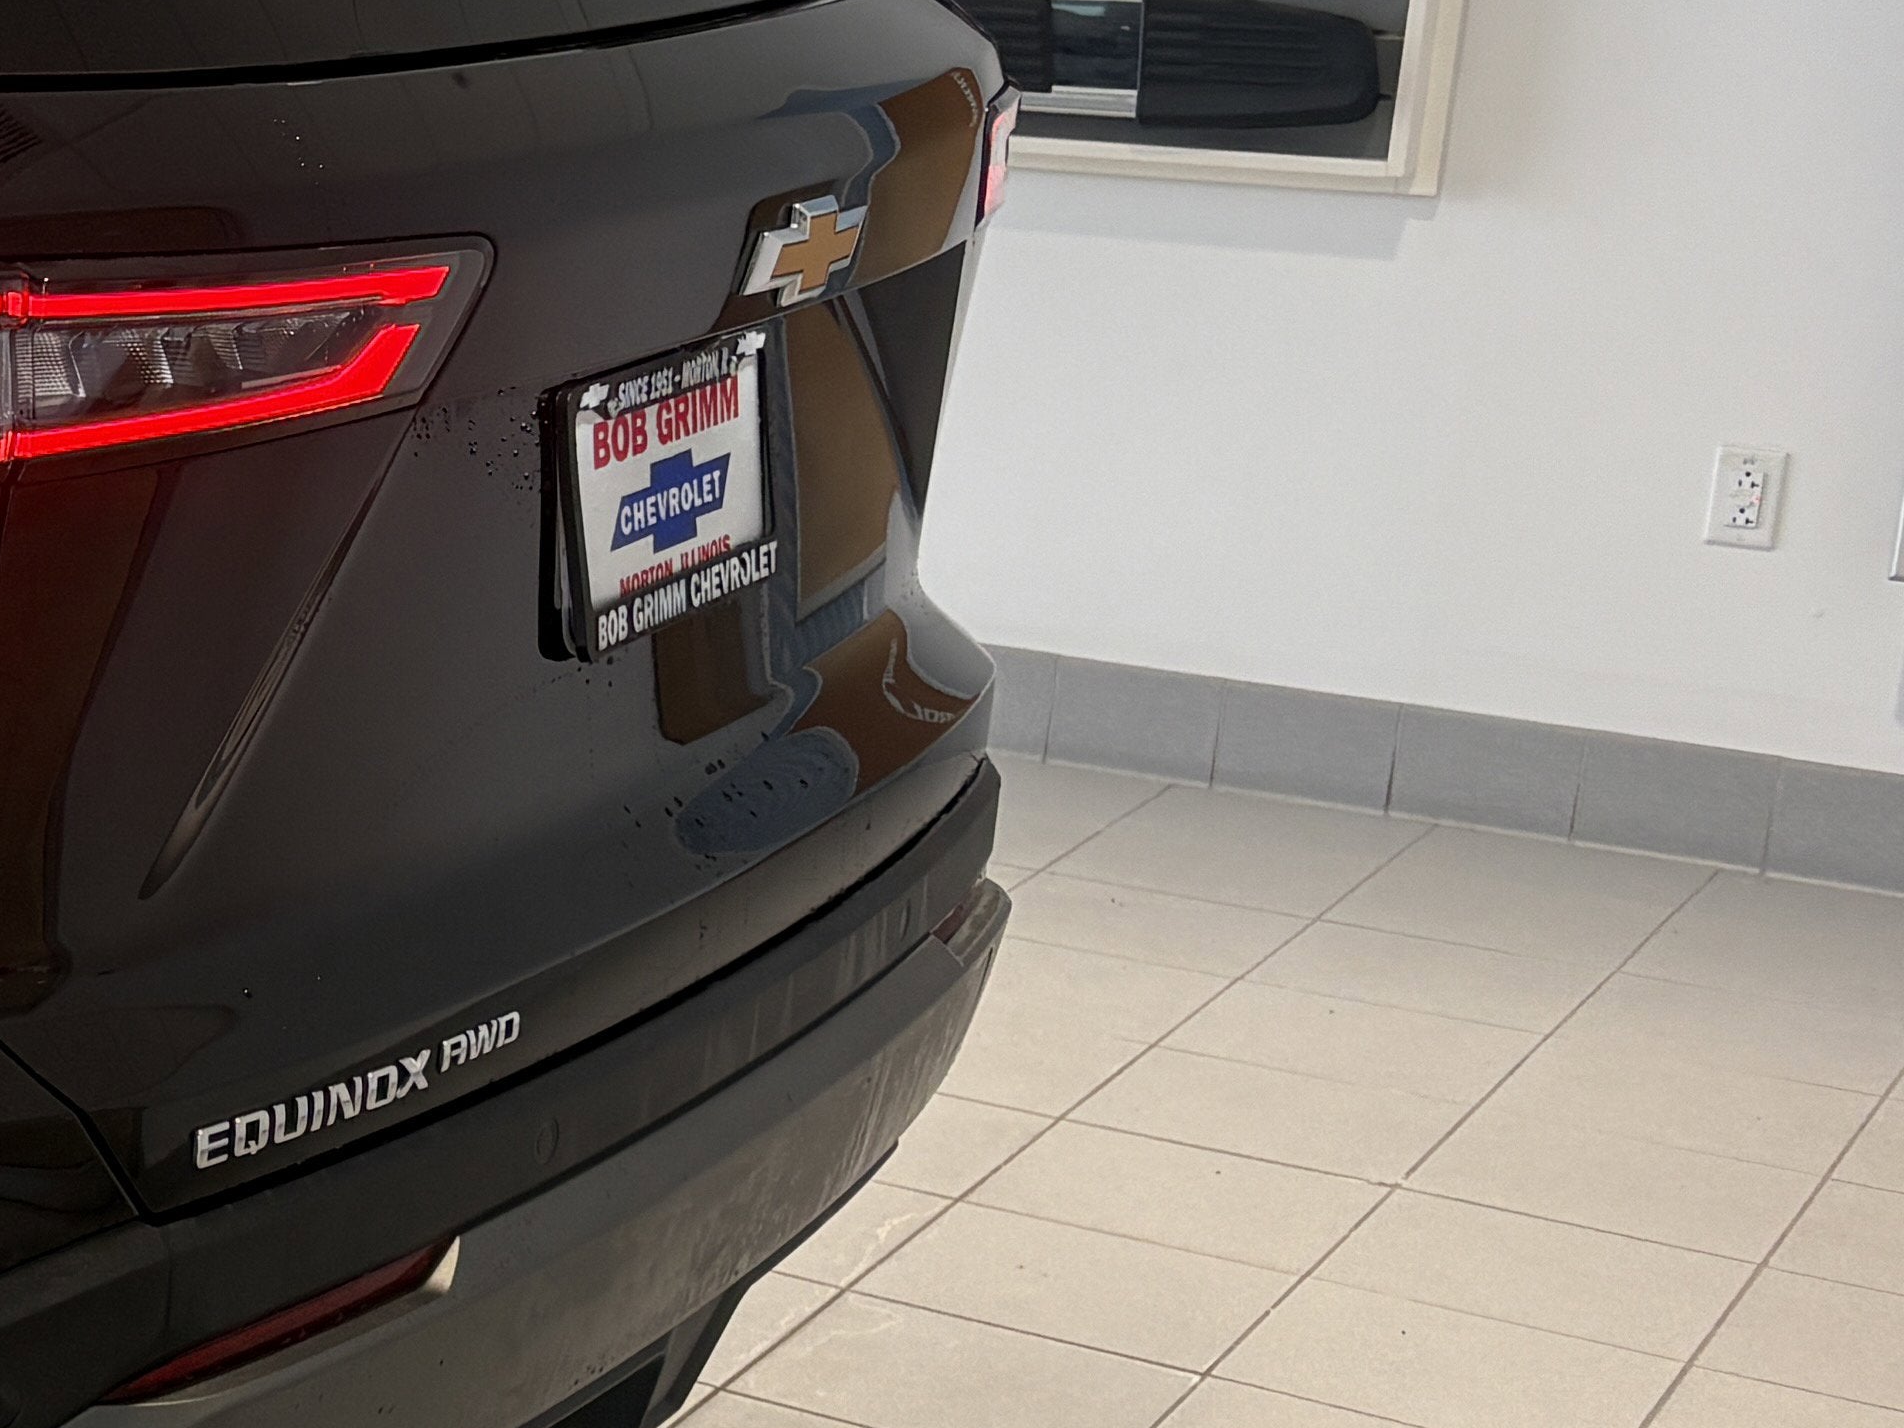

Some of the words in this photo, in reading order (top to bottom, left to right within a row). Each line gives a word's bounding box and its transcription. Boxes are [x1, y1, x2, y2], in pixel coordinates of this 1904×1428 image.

[593, 409, 648, 470] BOB
[656, 375, 740, 446] GRIMM
[618, 374, 648, 408] SINCE
[620, 470, 721, 535] CHEVROLET
[598, 605, 628, 651] BOB
[632, 577, 687, 633] GRIMM
[691, 540, 778, 607] CHEVROLET
[196, 1049, 431, 1169] EQUINOX
[440, 1010, 521, 1073] AWD
